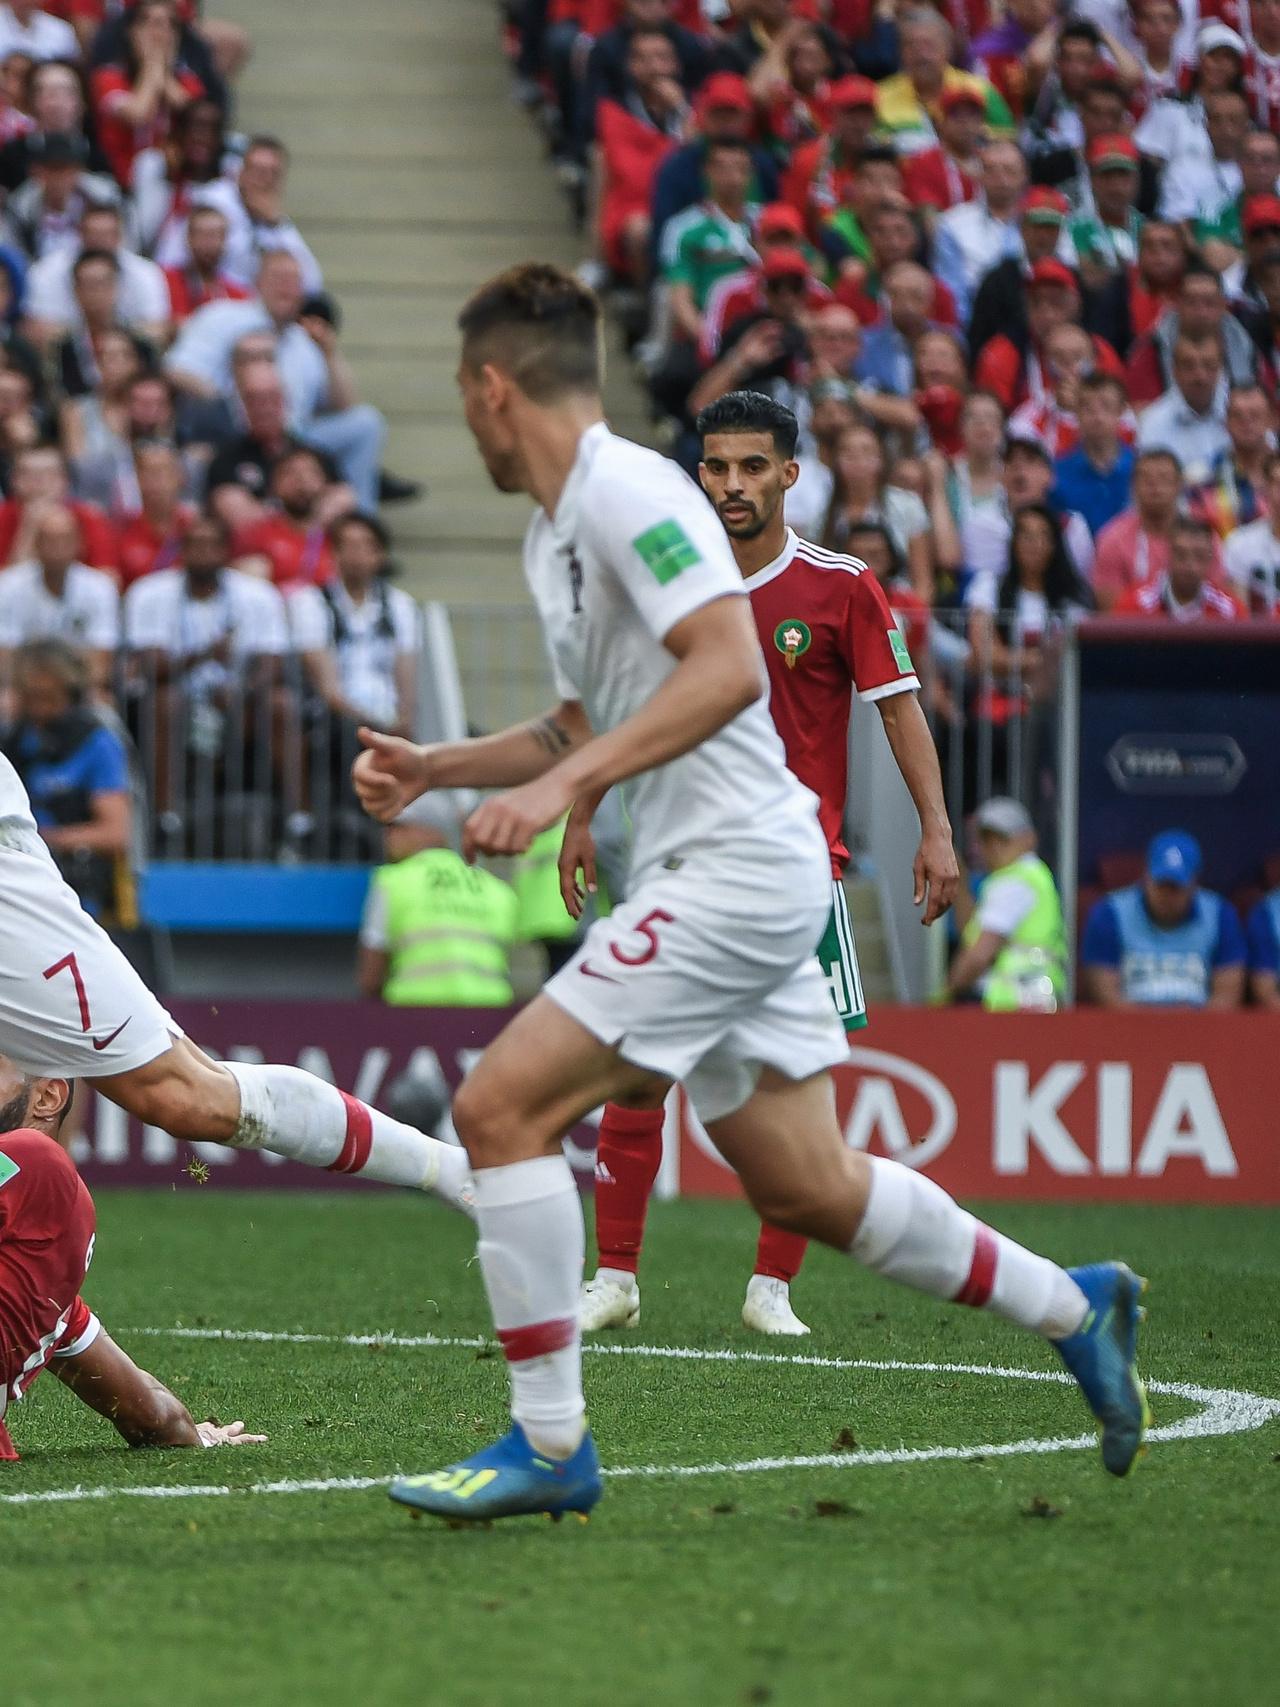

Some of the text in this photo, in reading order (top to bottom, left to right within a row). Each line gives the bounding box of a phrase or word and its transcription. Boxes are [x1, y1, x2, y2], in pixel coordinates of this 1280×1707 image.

[609, 907, 674, 966] 5
[42, 951, 91, 1033] 7
[992, 1060, 1238, 1178] KIA
